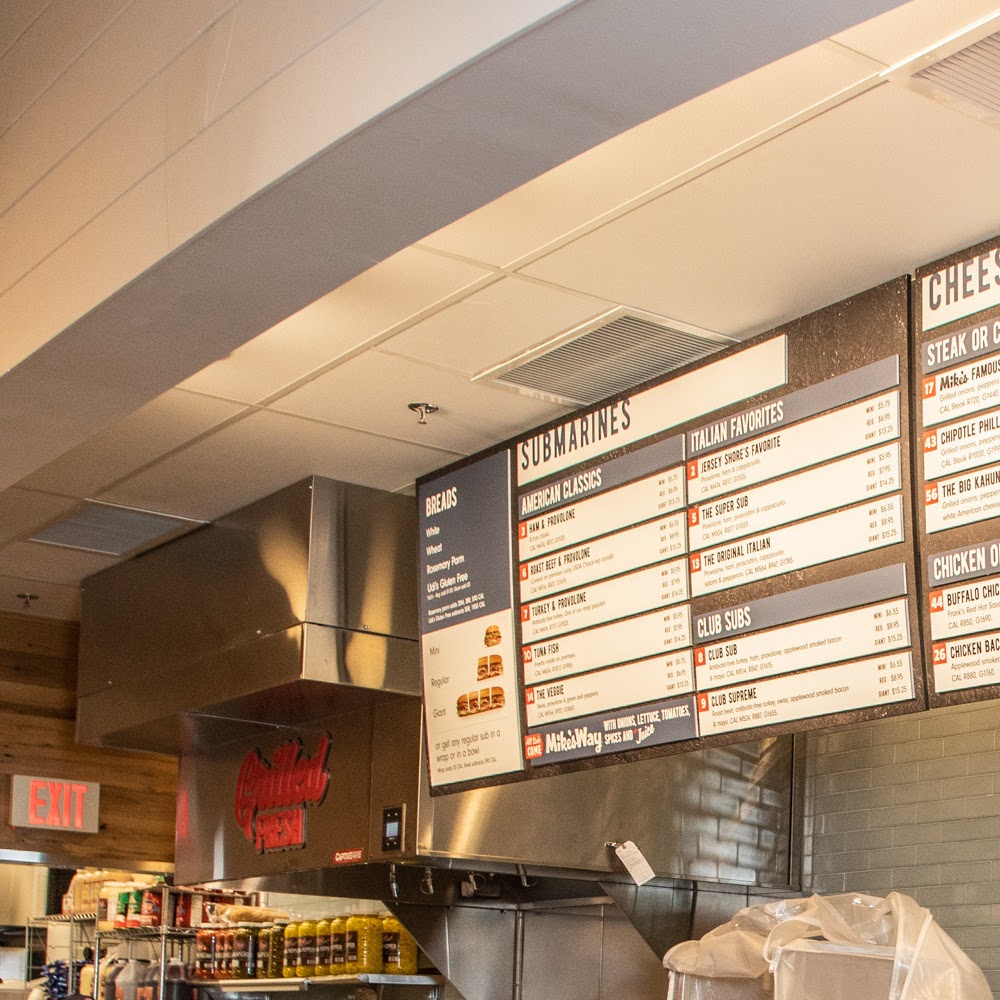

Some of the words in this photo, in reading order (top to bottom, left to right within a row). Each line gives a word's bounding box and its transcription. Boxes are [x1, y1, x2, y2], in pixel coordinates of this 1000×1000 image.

[927, 335, 967, 367] STEAK
[971, 325, 988, 351] OR
[940, 371, 969, 391] Mike's
[521, 399, 631, 471] SUBMARINES
[691, 420, 727, 452] ITALIAN
[731, 400, 783, 438] FAVORITES
[941, 423, 975, 445] CHIPOTLE
[701, 457, 722, 473] JERSEY
[725, 447, 749, 465] SHORE'S
[751, 436, 781, 456] FAVORITE
[521, 483, 561, 516] AMERICAN
[563, 468, 602, 499] CLASSICS
[942, 484, 957, 498] THE
[959, 478, 971, 492] BIG
[425, 486, 458, 517] BREADS
[702, 506, 713, 520] THE
[715, 501, 734, 516] SUPER
[737, 496, 748, 508] SUB
[529, 523, 540, 532] HAM
[542, 520, 545, 529] &
[548, 509, 575, 527] PROVOLONE
[426, 526, 440, 538] White
[426, 543, 442, 556] Wheat
[704, 553, 714, 567] THE
[717, 545, 744, 562] ORIGINAL
[747, 537, 770, 553] ITALIAN
[530, 561, 544, 575] ROAST
[546, 557, 557, 570] BEEF
[558, 556, 562, 566] &
[564, 547, 590, 564] PROVOLONE
[934, 546, 986, 580] CHICKEN
[532, 602, 550, 617] TURKEY
[552, 601, 555, 610] &
[558, 592, 586, 608] PROVOLONE
[947, 589, 979, 606] BUFFALO
[698, 613, 722, 638] CLUB
[725, 606, 751, 632] SUBS
[430, 646, 440, 656] Mini
[534, 645, 547, 658] TUNA
[548, 642, 559, 654] FISH
[708, 648, 723, 661] CLUB
[726, 644, 737, 656] SUB
[950, 641, 982, 659] CHICKEN
[951, 658, 980, 671] Applewood
[982, 655, 1000, 665] smoked
[431, 675, 449, 688] Regular
[536, 688, 545, 700] THE
[547, 685, 564, 698] VEGGIE
[712, 693, 727, 707] CLUB
[729, 688, 757, 703] SUPREME
[433, 708, 446, 718] Giant
[546, 730, 576, 753] Mike's
[576, 727, 602, 753] Way
[527, 746, 542, 757] COME
[28, 778, 89, 829] EXIT
